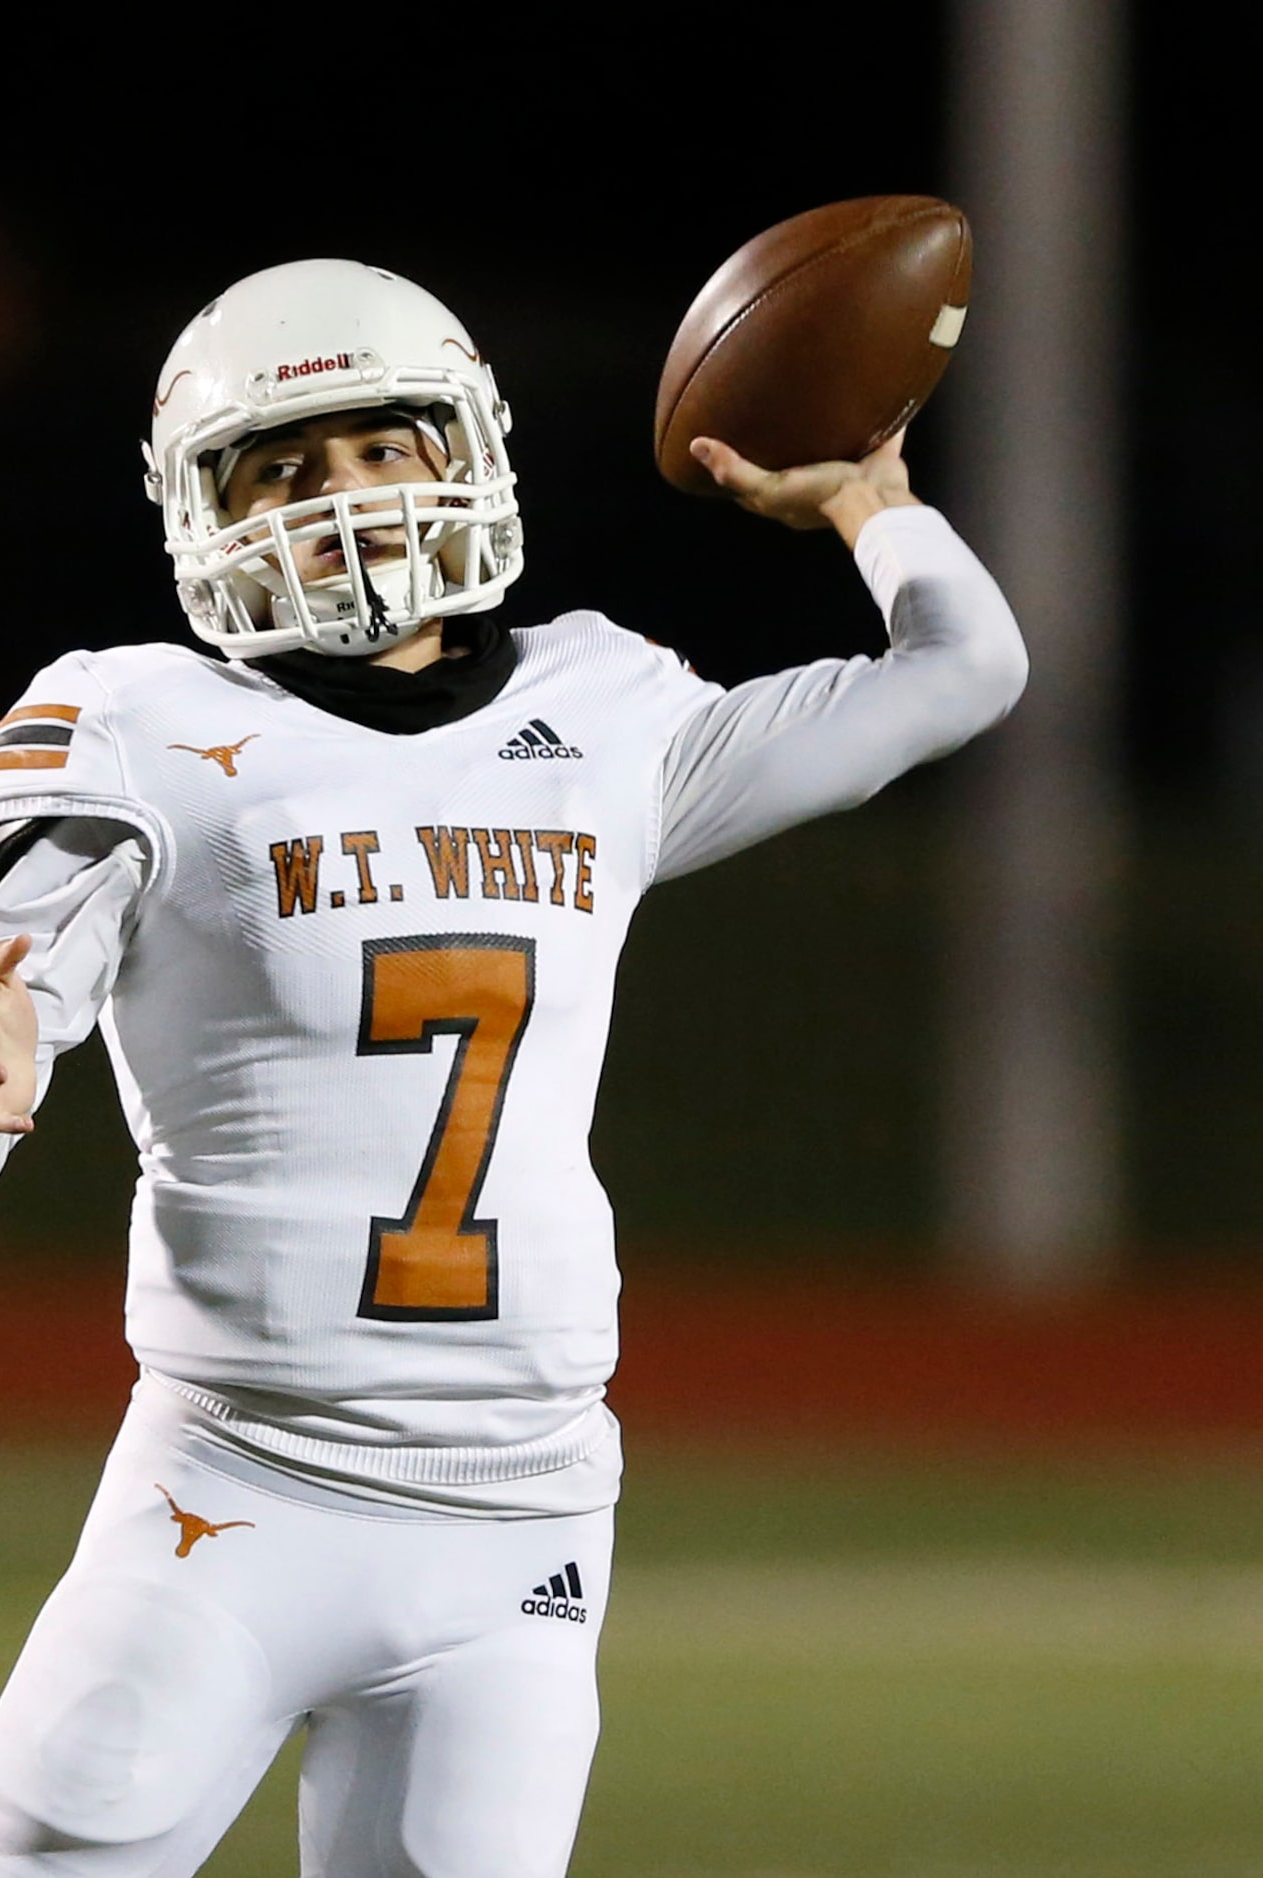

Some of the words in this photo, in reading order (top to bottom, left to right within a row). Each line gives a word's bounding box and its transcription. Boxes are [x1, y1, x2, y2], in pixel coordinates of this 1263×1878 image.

[277, 352, 352, 381] Riddell
[498, 744, 584, 760] adidas
[270, 830, 403, 919] W.T.
[415, 825, 597, 915] WHITE
[356, 932, 537, 1322] 7
[520, 1595, 588, 1624] adidas
